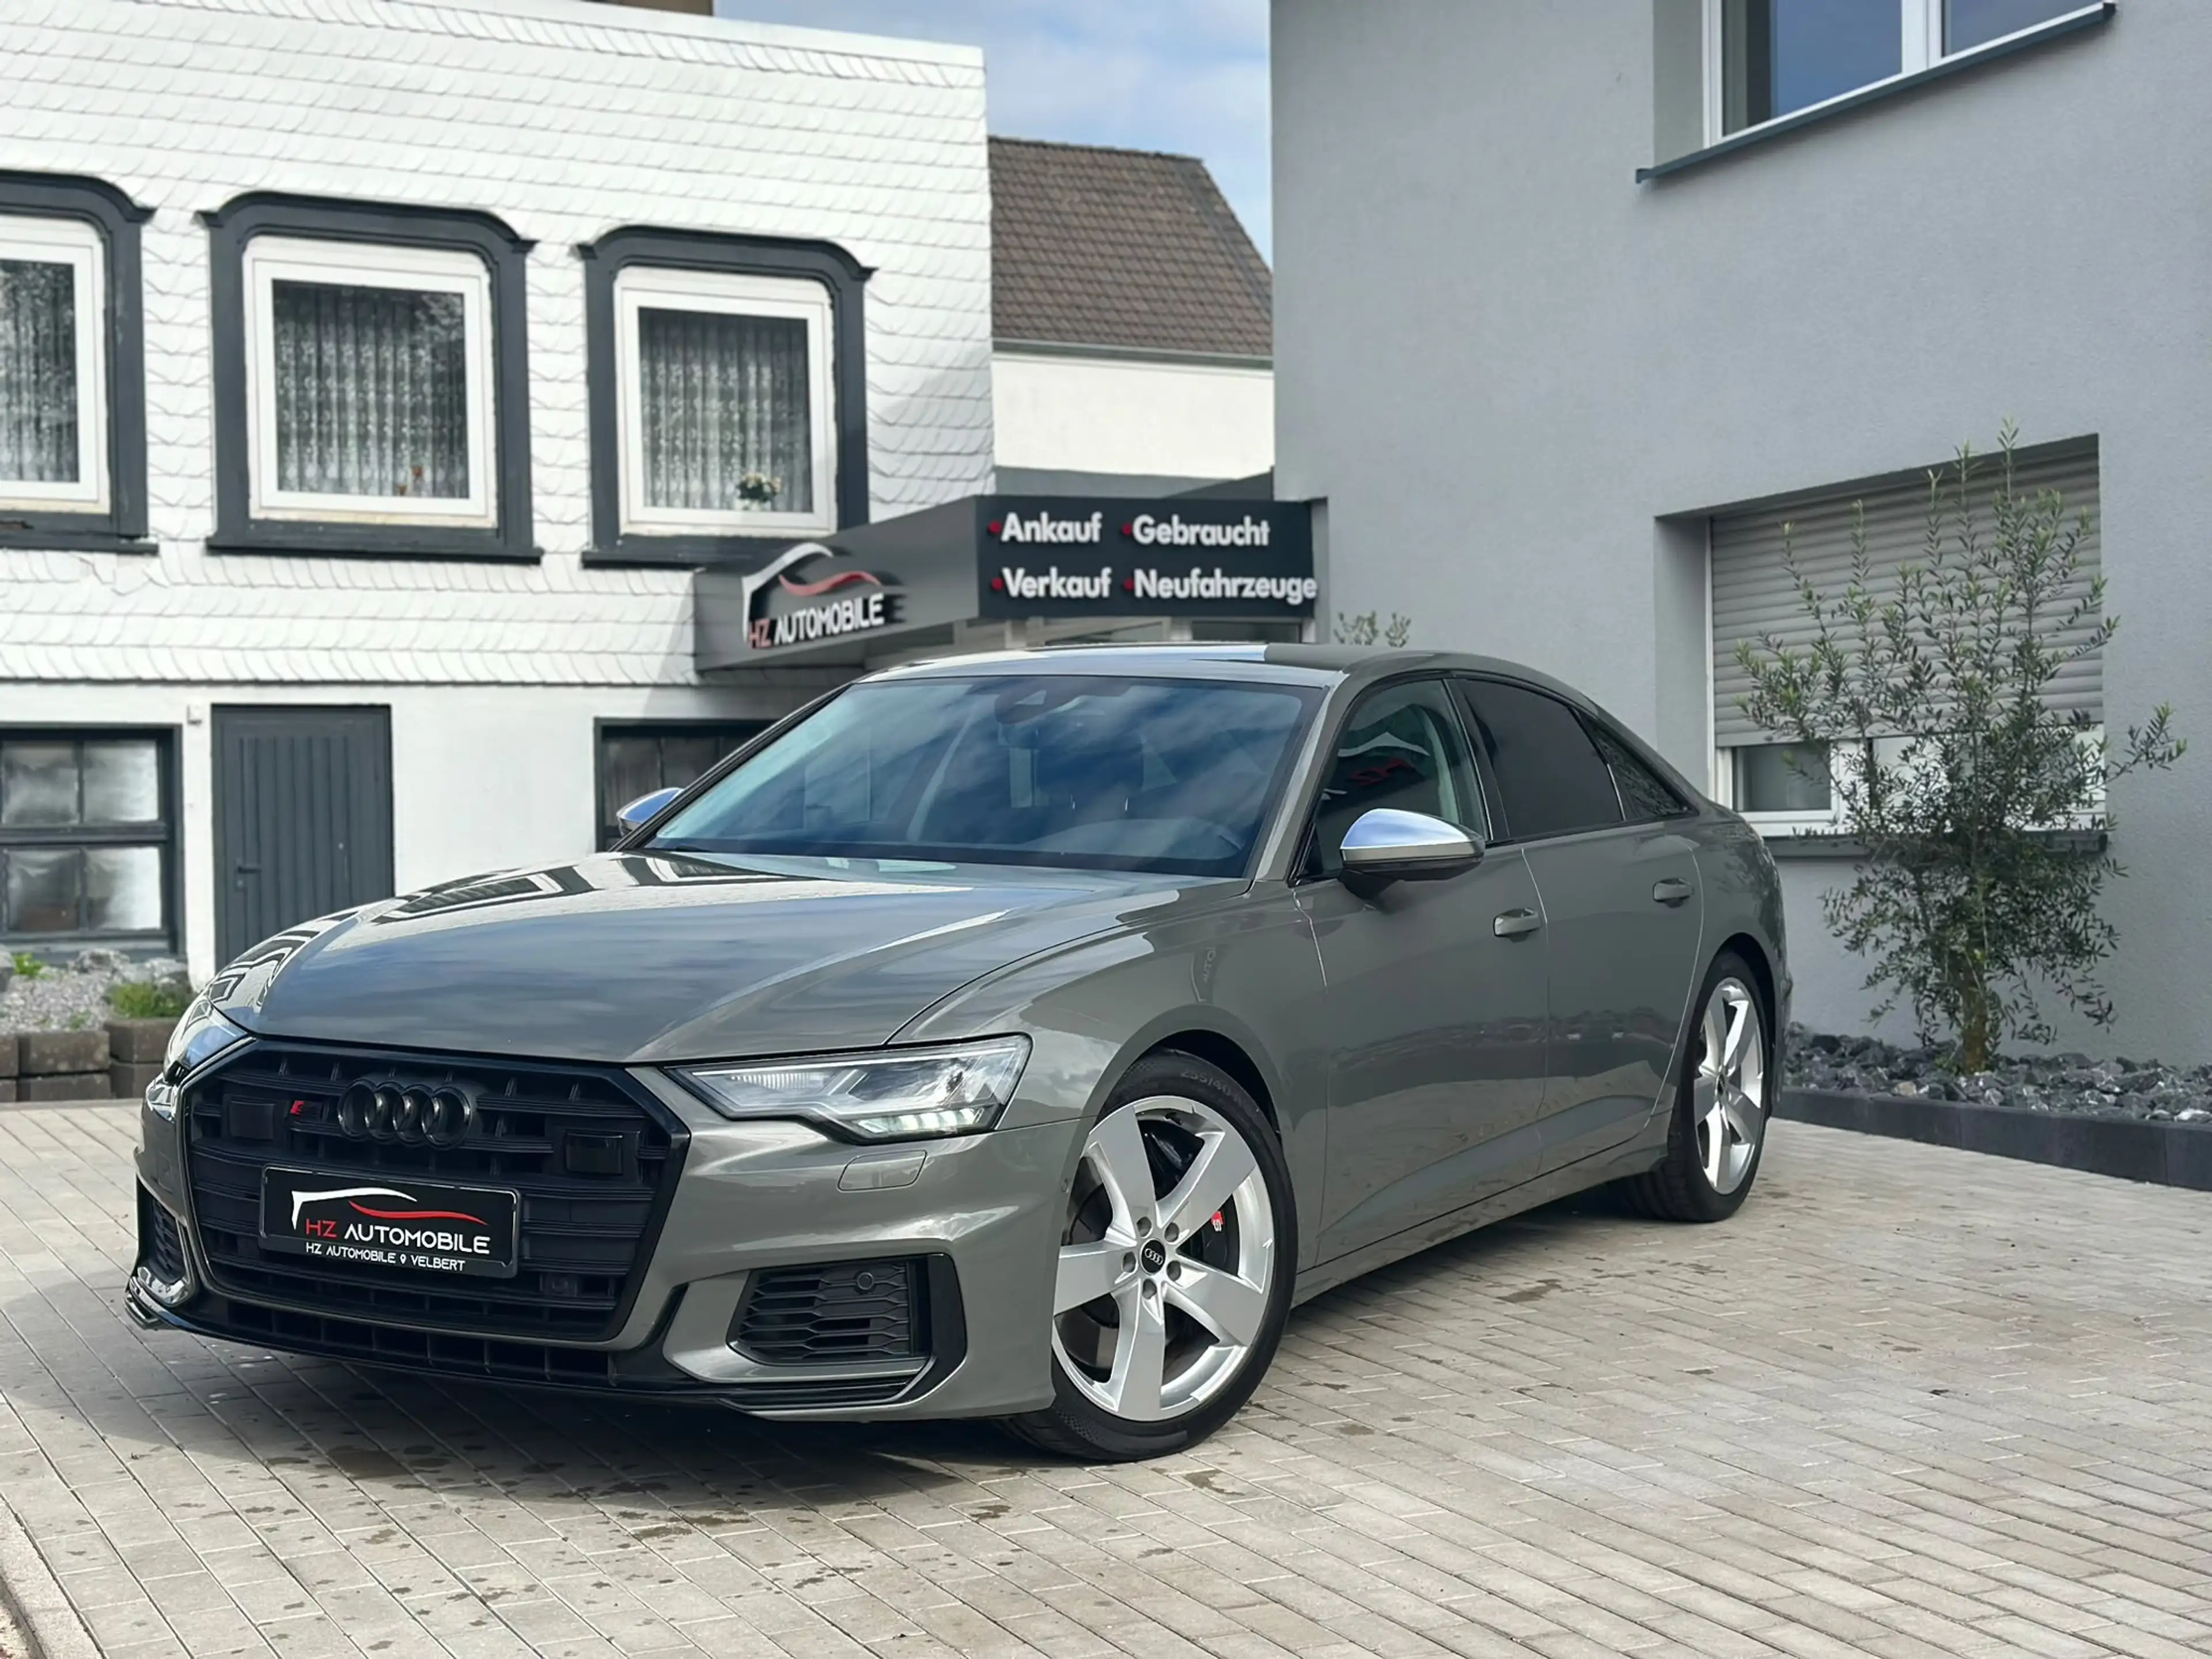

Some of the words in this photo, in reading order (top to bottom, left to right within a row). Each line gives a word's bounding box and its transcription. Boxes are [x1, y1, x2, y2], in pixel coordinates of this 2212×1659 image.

[1001, 512, 1103, 543] Ankauf
[1132, 514, 1270, 546] Gebraucht
[1002, 566, 1112, 598] Verkauf
[1134, 568, 1318, 605] Neufahrzeuge
[749, 618, 771, 649] HZ
[774, 592, 884, 645] AUTOMOBILE
[306, 1218, 337, 1238] HZ
[344, 1223, 491, 1255] AUTOMOBILE
[306, 1242, 323, 1255] HZ
[326, 1245, 396, 1264] AUTOMOBILE
[410, 1255, 466, 1271] VELBERT
